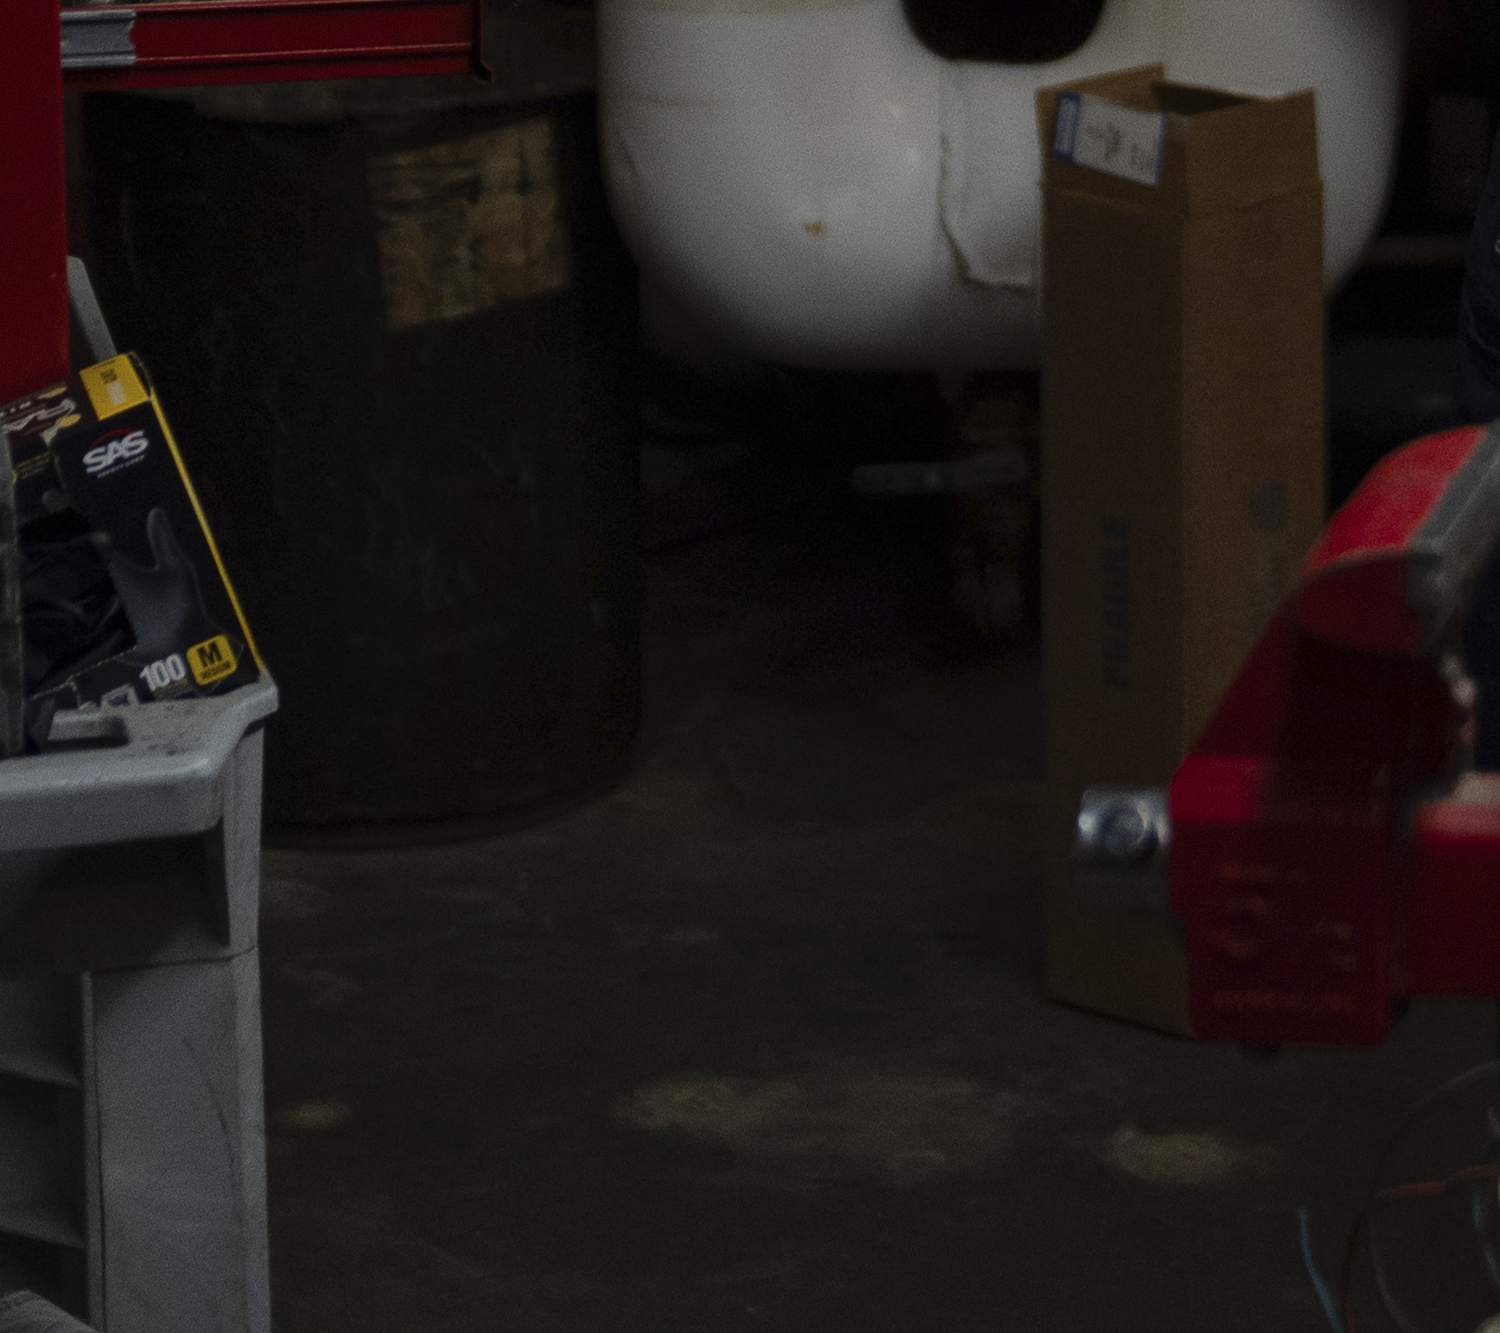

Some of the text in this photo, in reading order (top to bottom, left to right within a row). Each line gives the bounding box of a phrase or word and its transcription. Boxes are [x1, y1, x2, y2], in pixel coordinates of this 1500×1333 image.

[82, 430, 149, 475] SAS
[139, 652, 187, 693] 100
[197, 642, 222, 669] M
